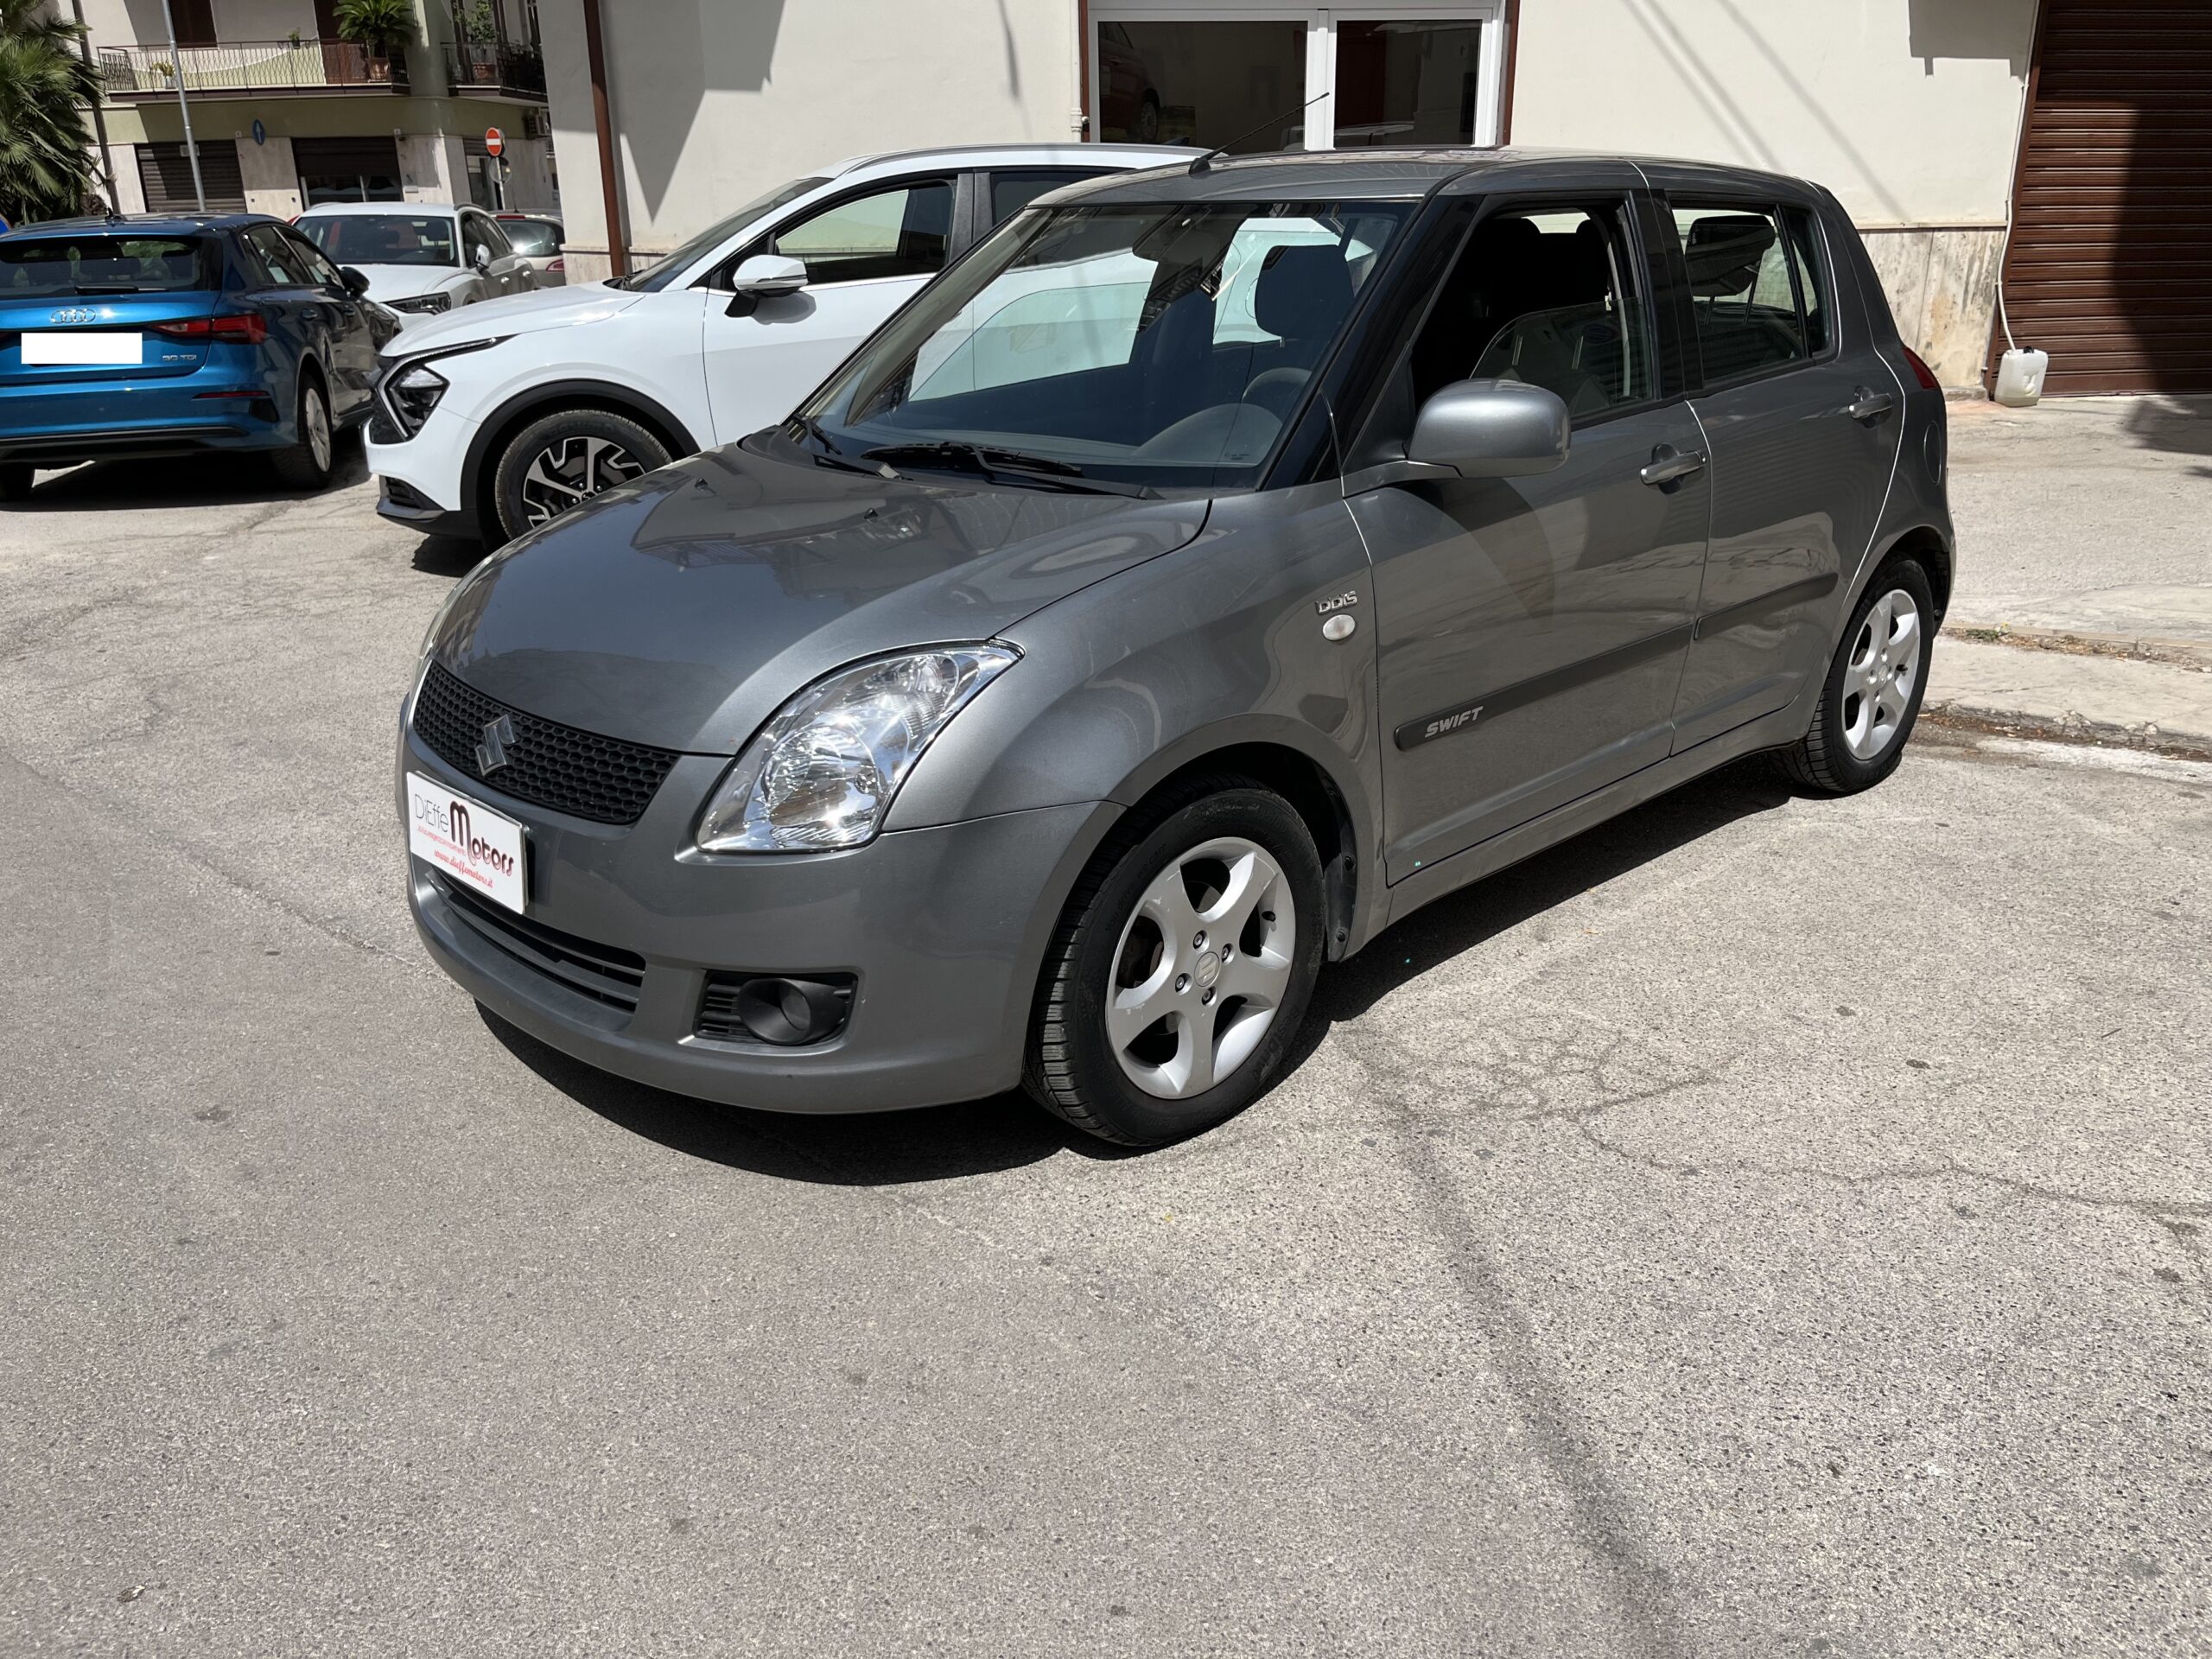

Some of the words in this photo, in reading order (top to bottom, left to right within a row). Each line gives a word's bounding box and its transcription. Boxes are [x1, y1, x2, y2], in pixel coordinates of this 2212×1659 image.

[1424, 705, 1484, 739] SWIFT
[414, 793, 449, 834] DiEffe
[449, 800, 515, 877] Motors
